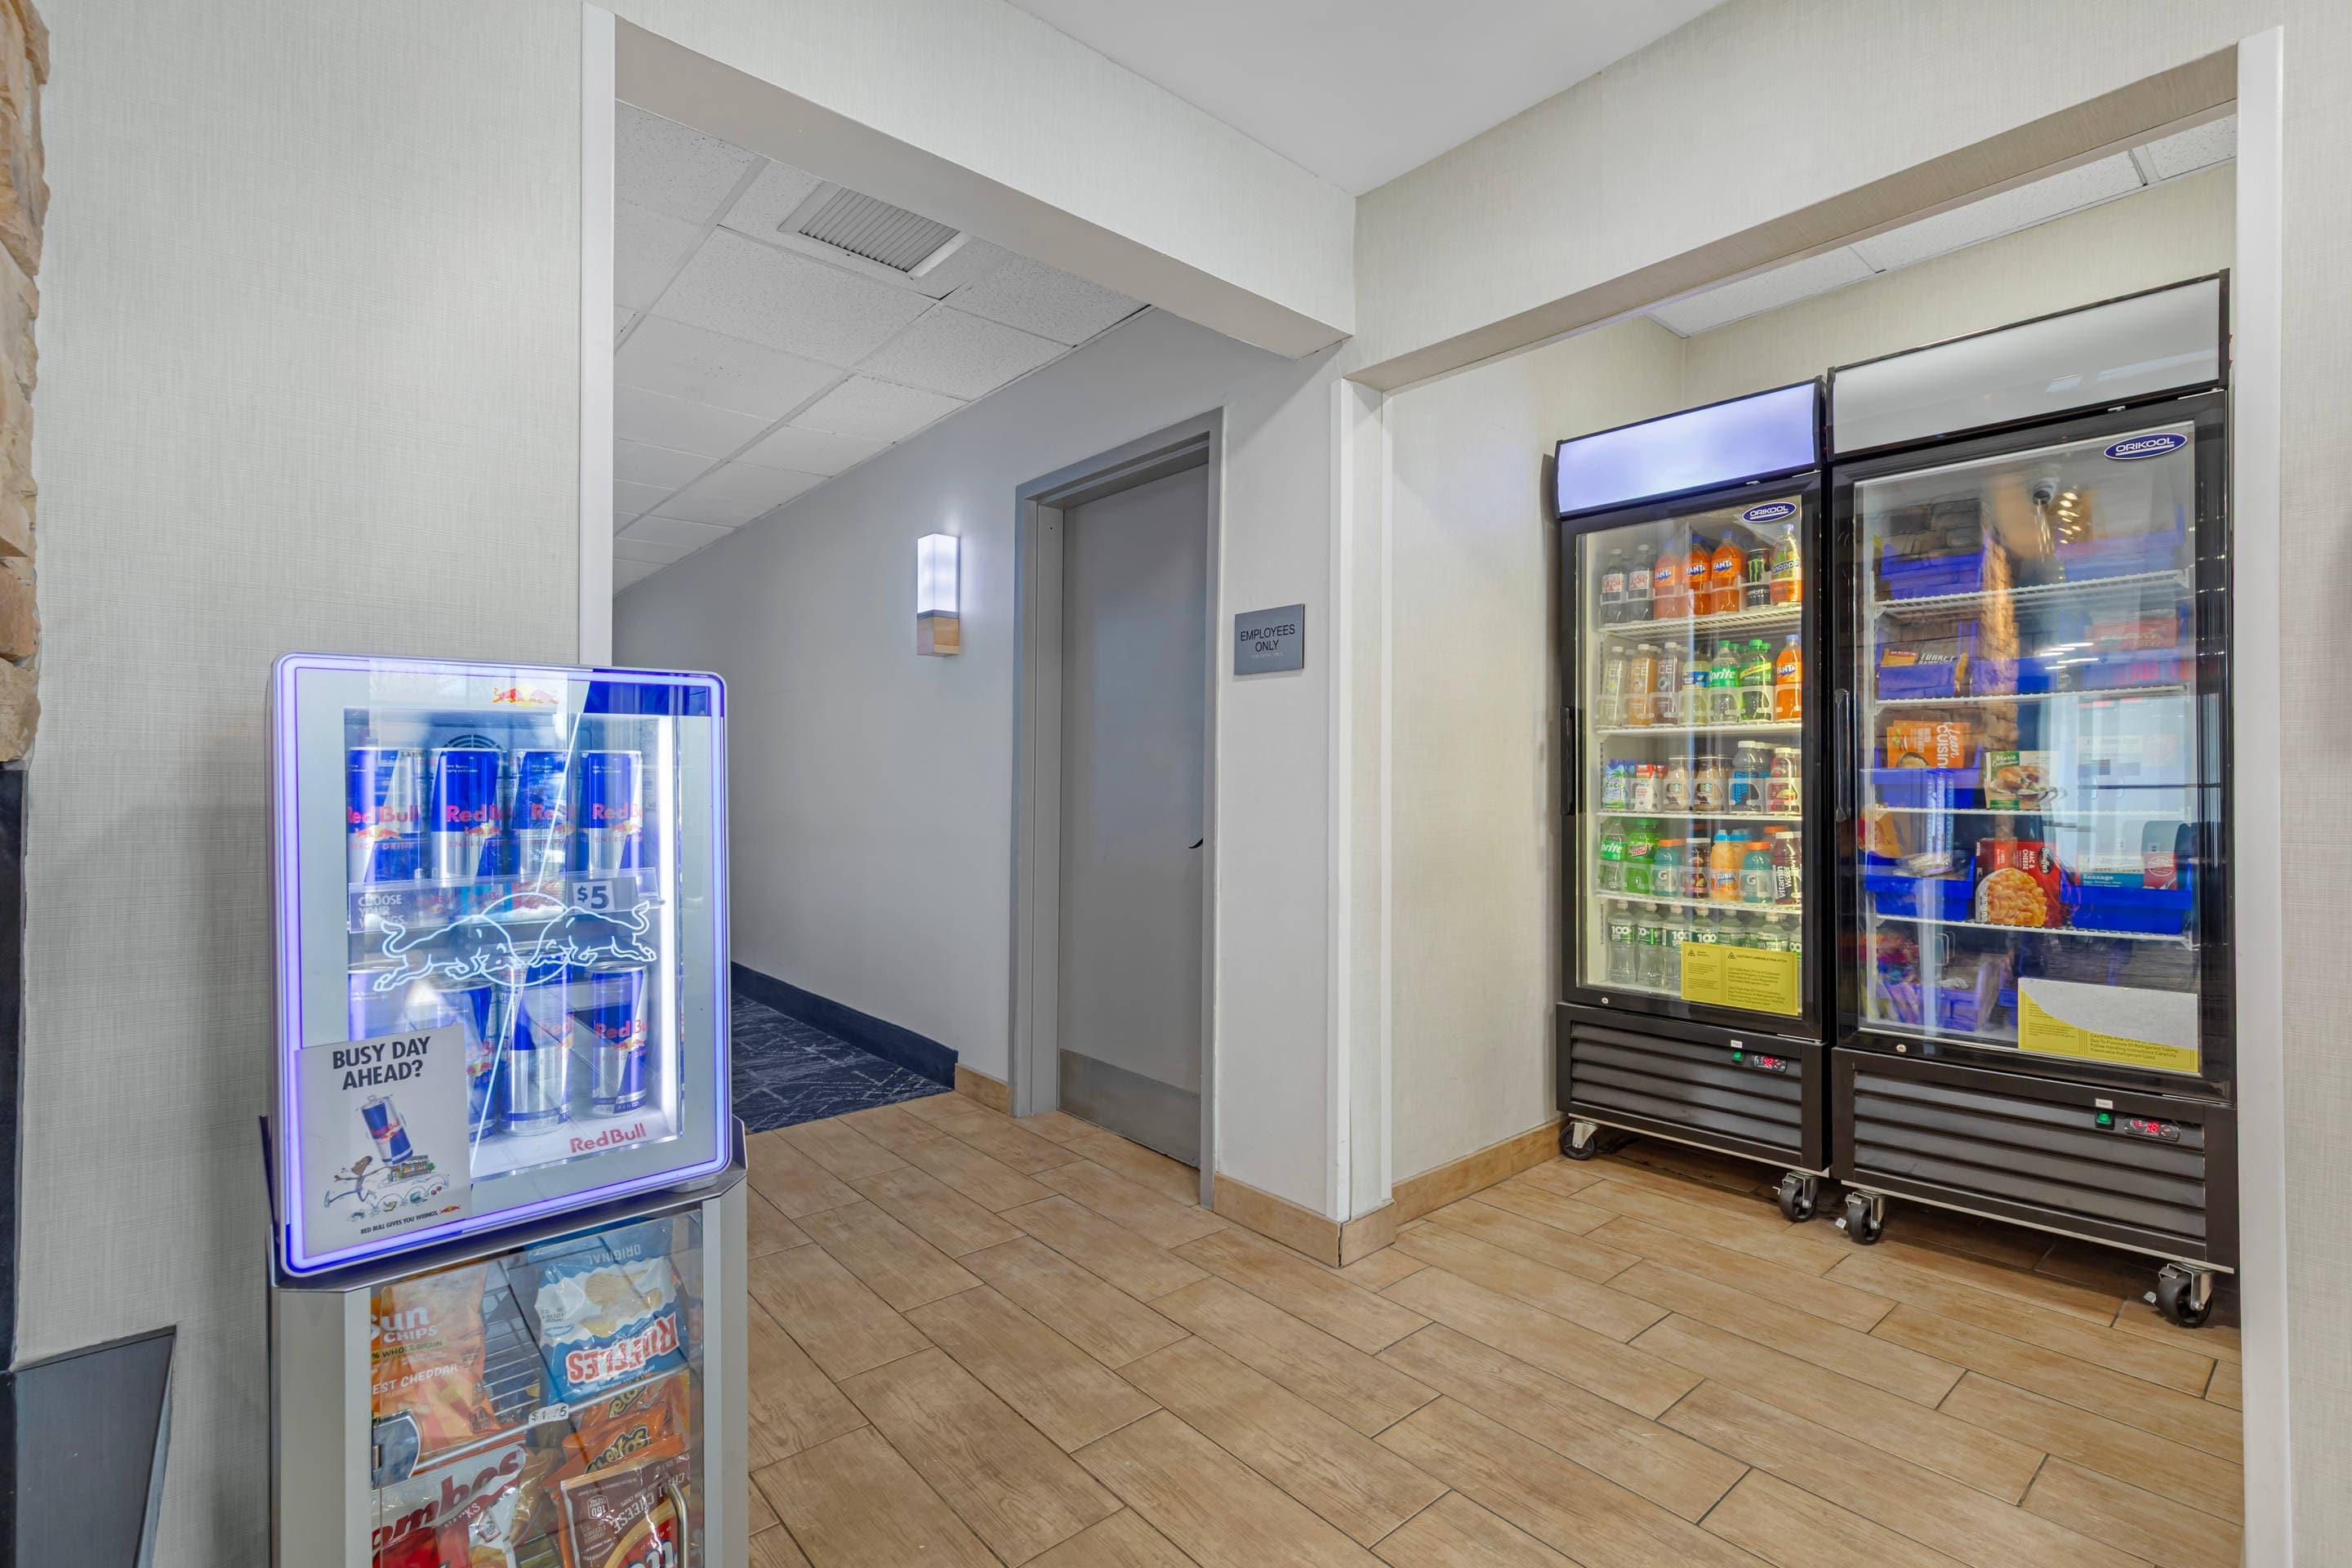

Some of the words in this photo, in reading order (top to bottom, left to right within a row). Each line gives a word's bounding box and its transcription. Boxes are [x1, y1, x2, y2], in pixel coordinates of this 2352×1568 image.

[2115, 437, 2175, 452] ORIKOOL
[1749, 506, 1788, 517] ORIKOOL
[1241, 624, 1295, 641] EMPLOYEES
[1255, 639, 1280, 653] ONLY
[1944, 721, 1961, 758] Lean
[446, 804, 488, 823] Red
[592, 802, 628, 820] Red
[1777, 866, 1786, 898] vitamin
[1783, 866, 1793, 888] water
[2083, 873, 2114, 881] Sausage
[577, 885, 609, 909] $5
[595, 1020, 630, 1040] Red
[332, 1043, 385, 1070] BUSY
[392, 1036, 430, 1059] DAY
[342, 1059, 423, 1090] AHEAD?
[569, 1130, 609, 1153] Red
[609, 1122, 647, 1144] Bull
[360, 1227, 372, 1235] RED
[372, 1223, 385, 1232] BULL
[385, 1219, 403, 1227] GIVES
[403, 1215, 416, 1224] YOU
[585, 1244, 642, 1265] ORIGINAL
[383, 1324, 439, 1343] CHIPS
[382, 1344, 414, 1358] WHOLE
[568, 1312, 679, 1382] RUFFLES
[400, 1364, 459, 1388] CHEDDAR
[591, 1505, 607, 1518] 160
[612, 1492, 655, 1535] CHEESE
